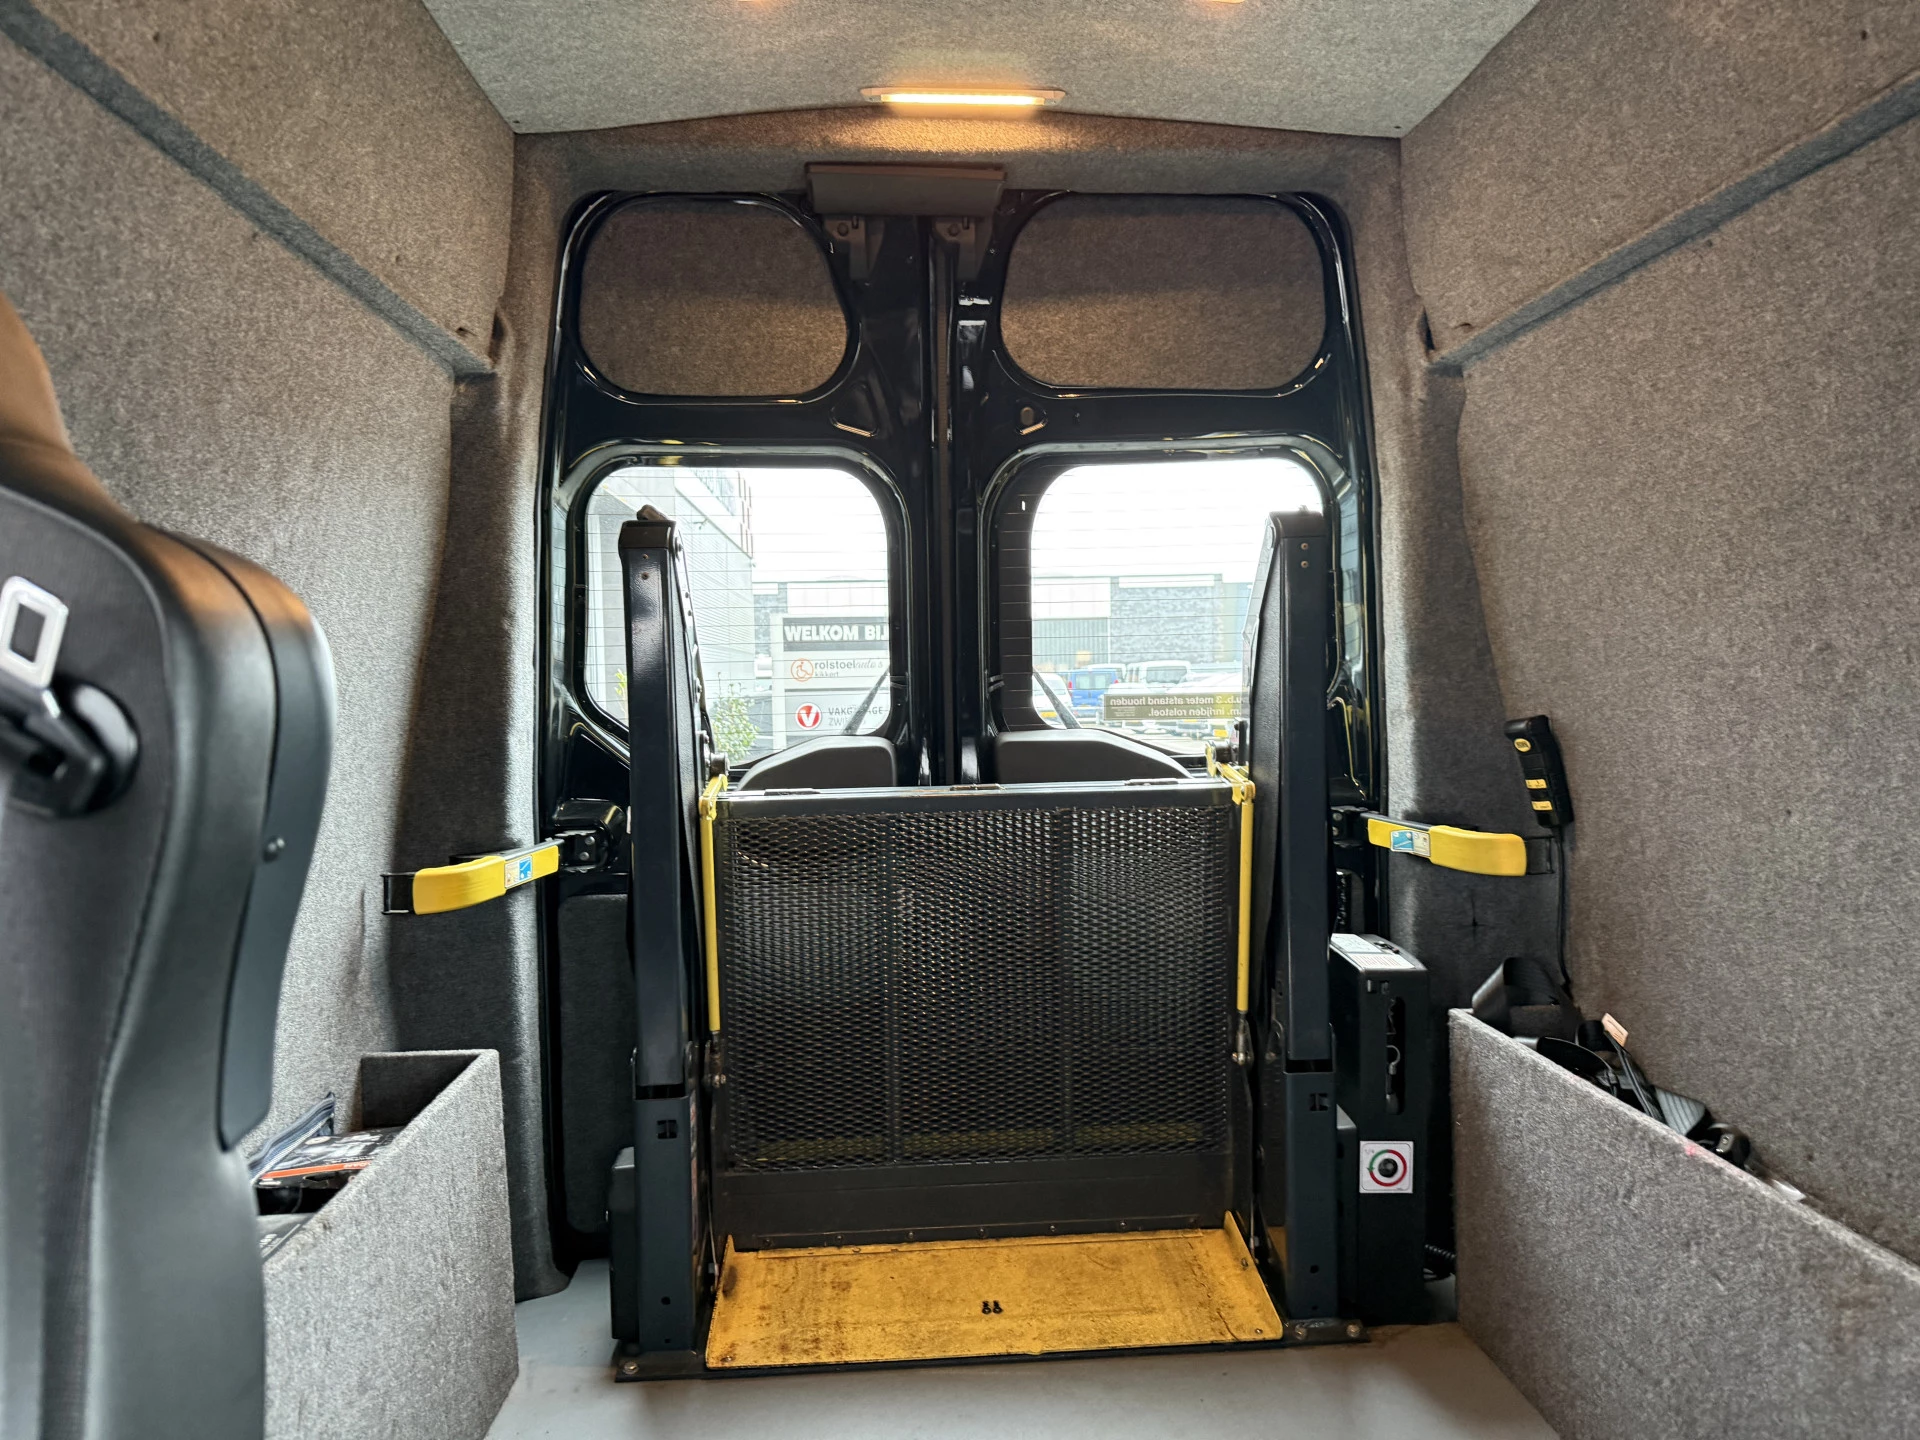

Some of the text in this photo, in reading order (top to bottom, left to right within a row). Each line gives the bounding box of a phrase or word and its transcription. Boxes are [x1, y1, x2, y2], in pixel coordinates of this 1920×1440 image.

[784, 624, 888, 641] WELKOM BIJ
[828, 706, 883, 716] VAKGGE
